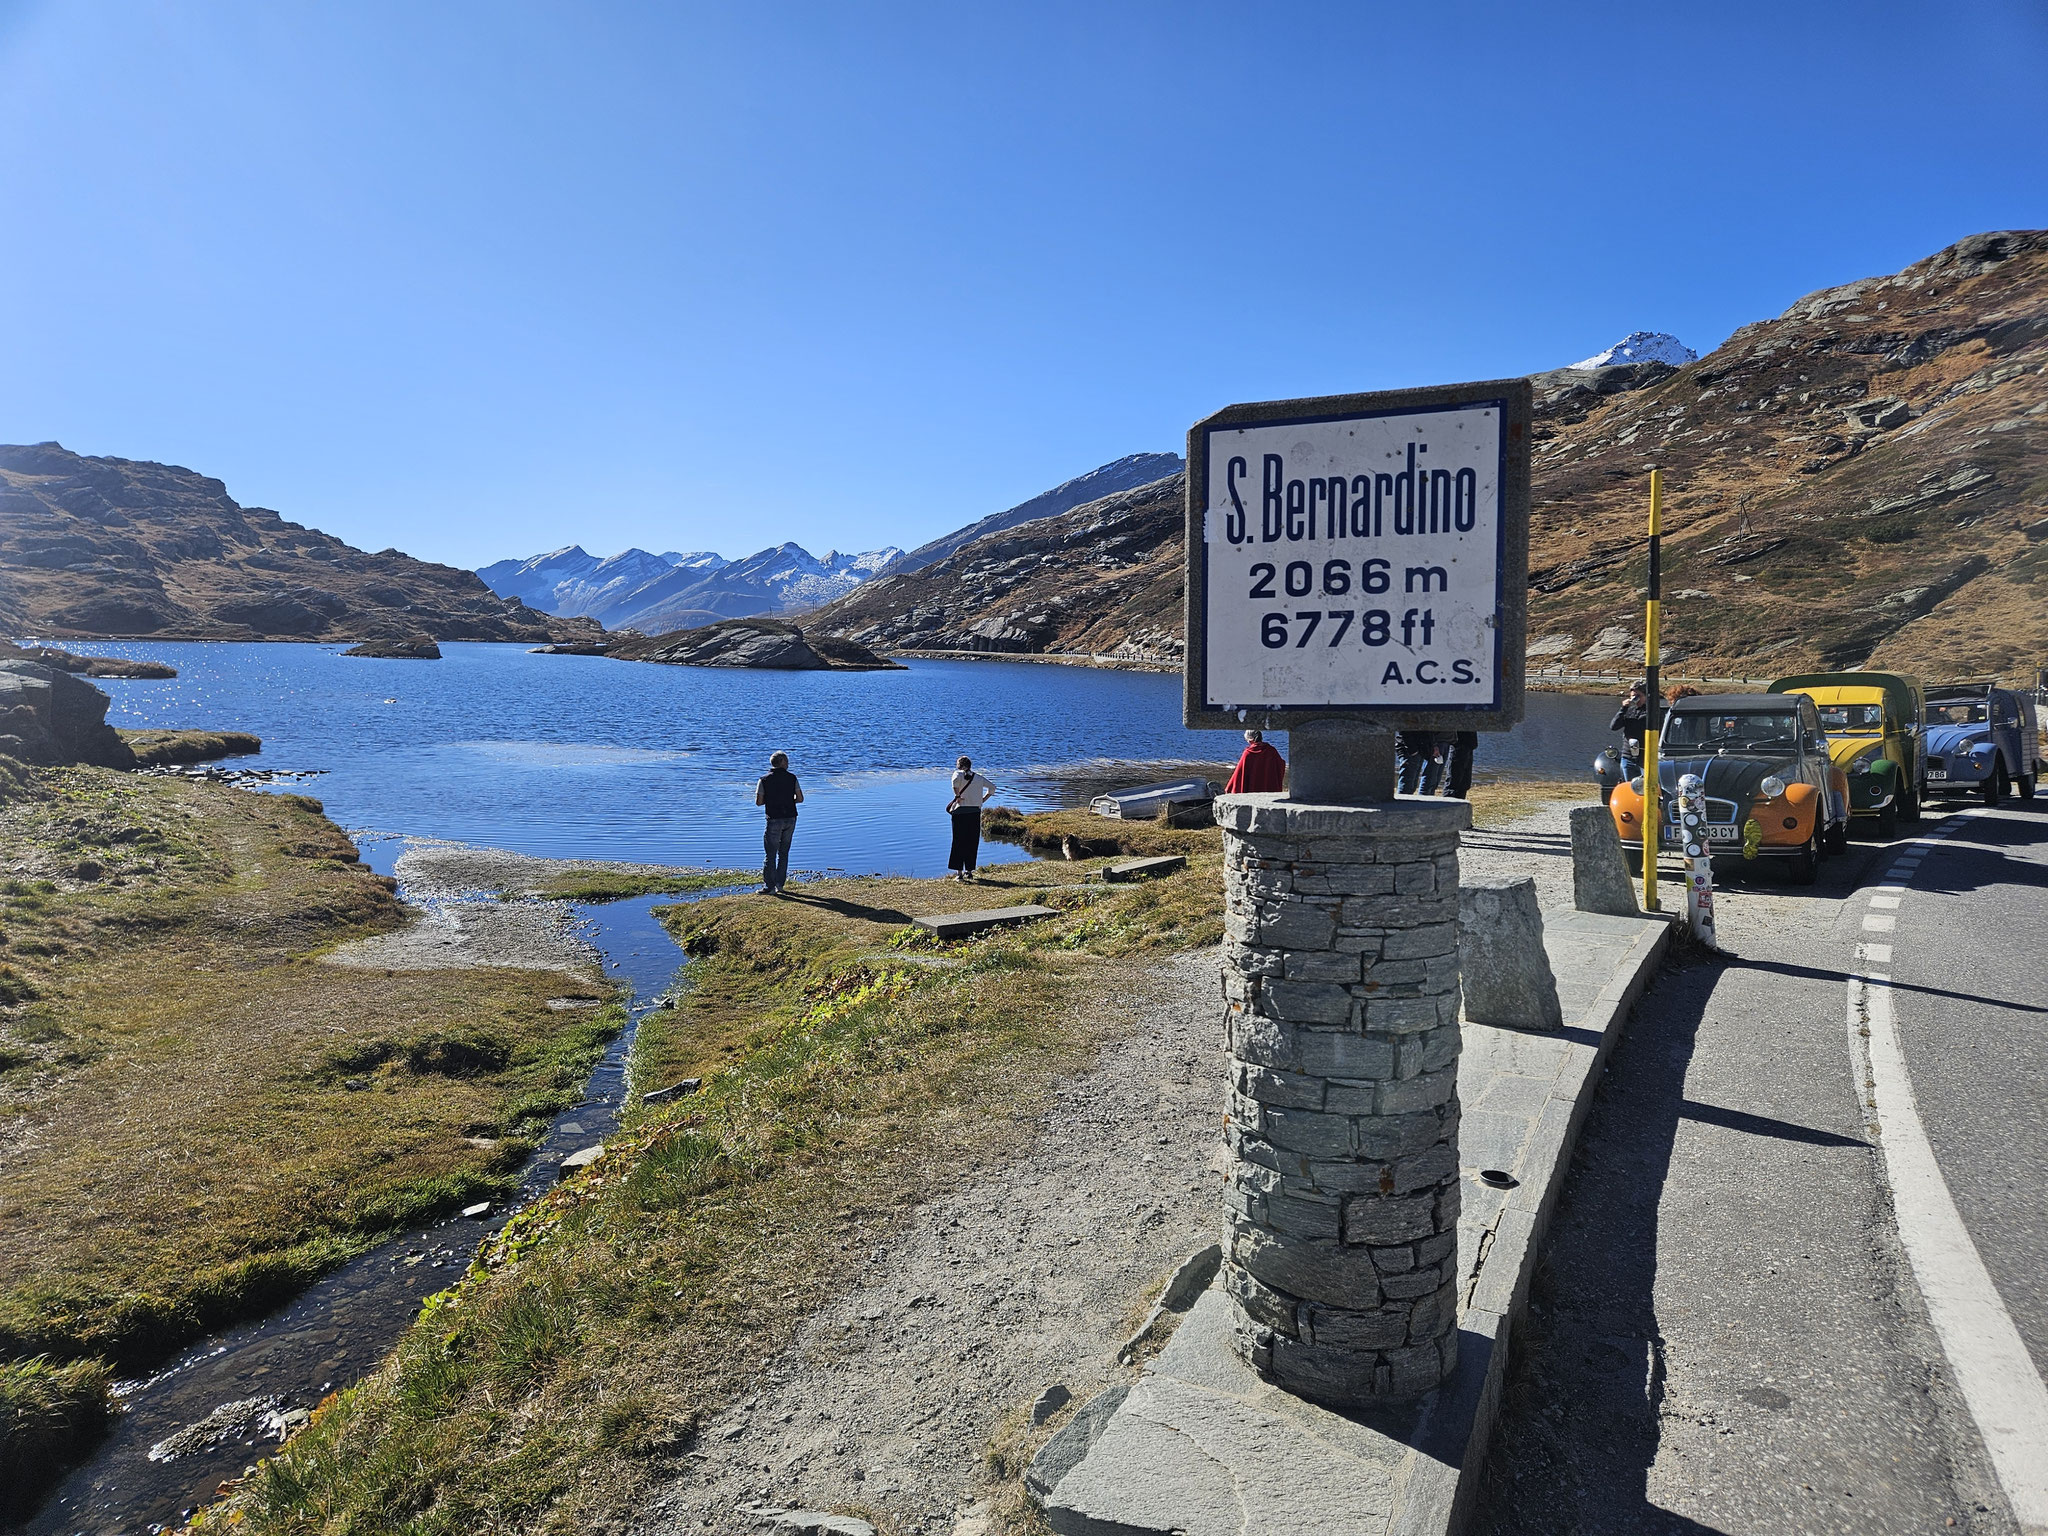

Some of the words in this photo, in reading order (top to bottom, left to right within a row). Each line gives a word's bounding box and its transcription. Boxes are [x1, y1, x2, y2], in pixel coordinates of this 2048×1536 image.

[1249, 558, 1391, 599] 2066
[1405, 566, 1448, 593] m
[1261, 609, 1391, 649] 6778
[1400, 608, 1435, 646] ft
[1381, 659, 1481, 685] A.C.S.
[1720, 827, 1735, 838] CY
